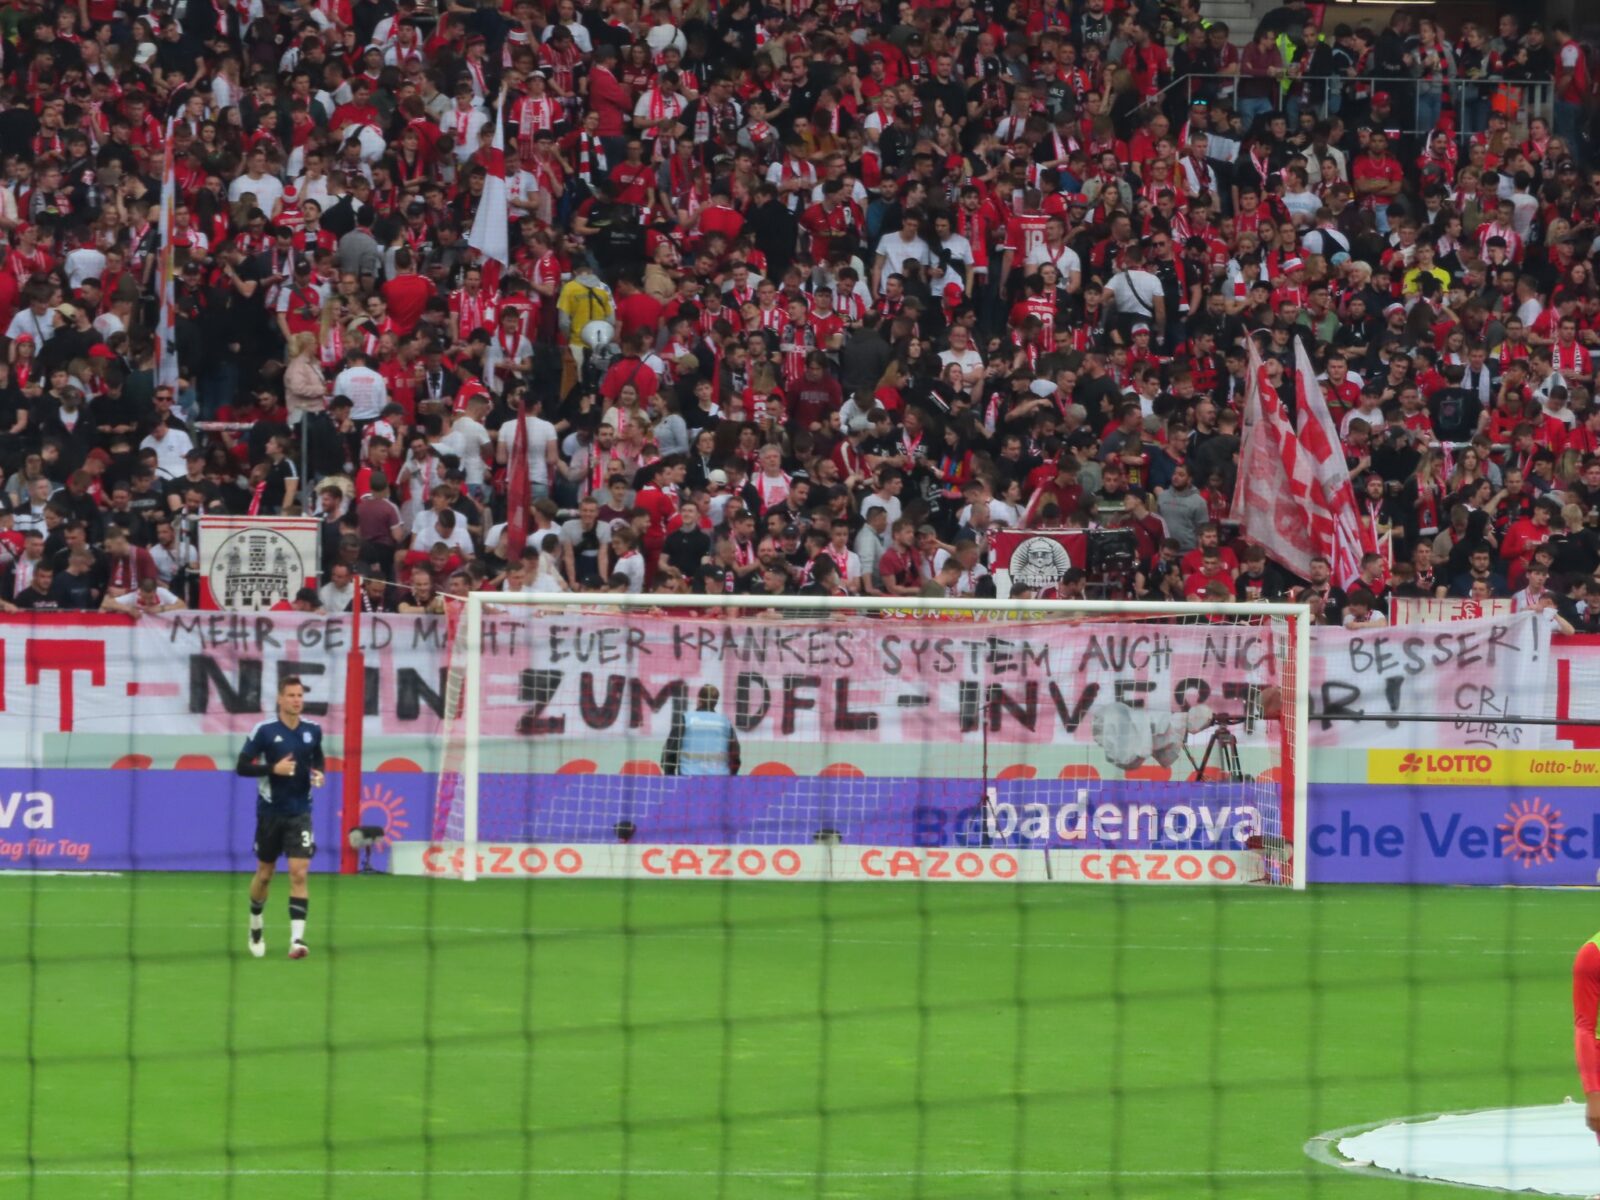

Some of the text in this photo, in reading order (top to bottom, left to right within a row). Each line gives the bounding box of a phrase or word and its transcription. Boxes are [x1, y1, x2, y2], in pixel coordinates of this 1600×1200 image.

[170, 614, 281, 648] MEHR
[297, 617, 392, 650] GED
[549, 624, 652, 664] EUER
[672, 624, 855, 668] KRANKES
[881, 634, 1051, 676] SYSTEM
[1079, 633, 1173, 674] AUCH
[515, 669, 689, 735] ZUM
[1427, 755, 1492, 772] LOTTO
[986, 788, 1263, 842] badenova
[28, 839, 55, 856] für
[58, 839, 91, 863] Tag
[641, 848, 801, 875] CAZOO
[860, 849, 1018, 878] CAZOO
[1080, 853, 1236, 880] CAZOO
